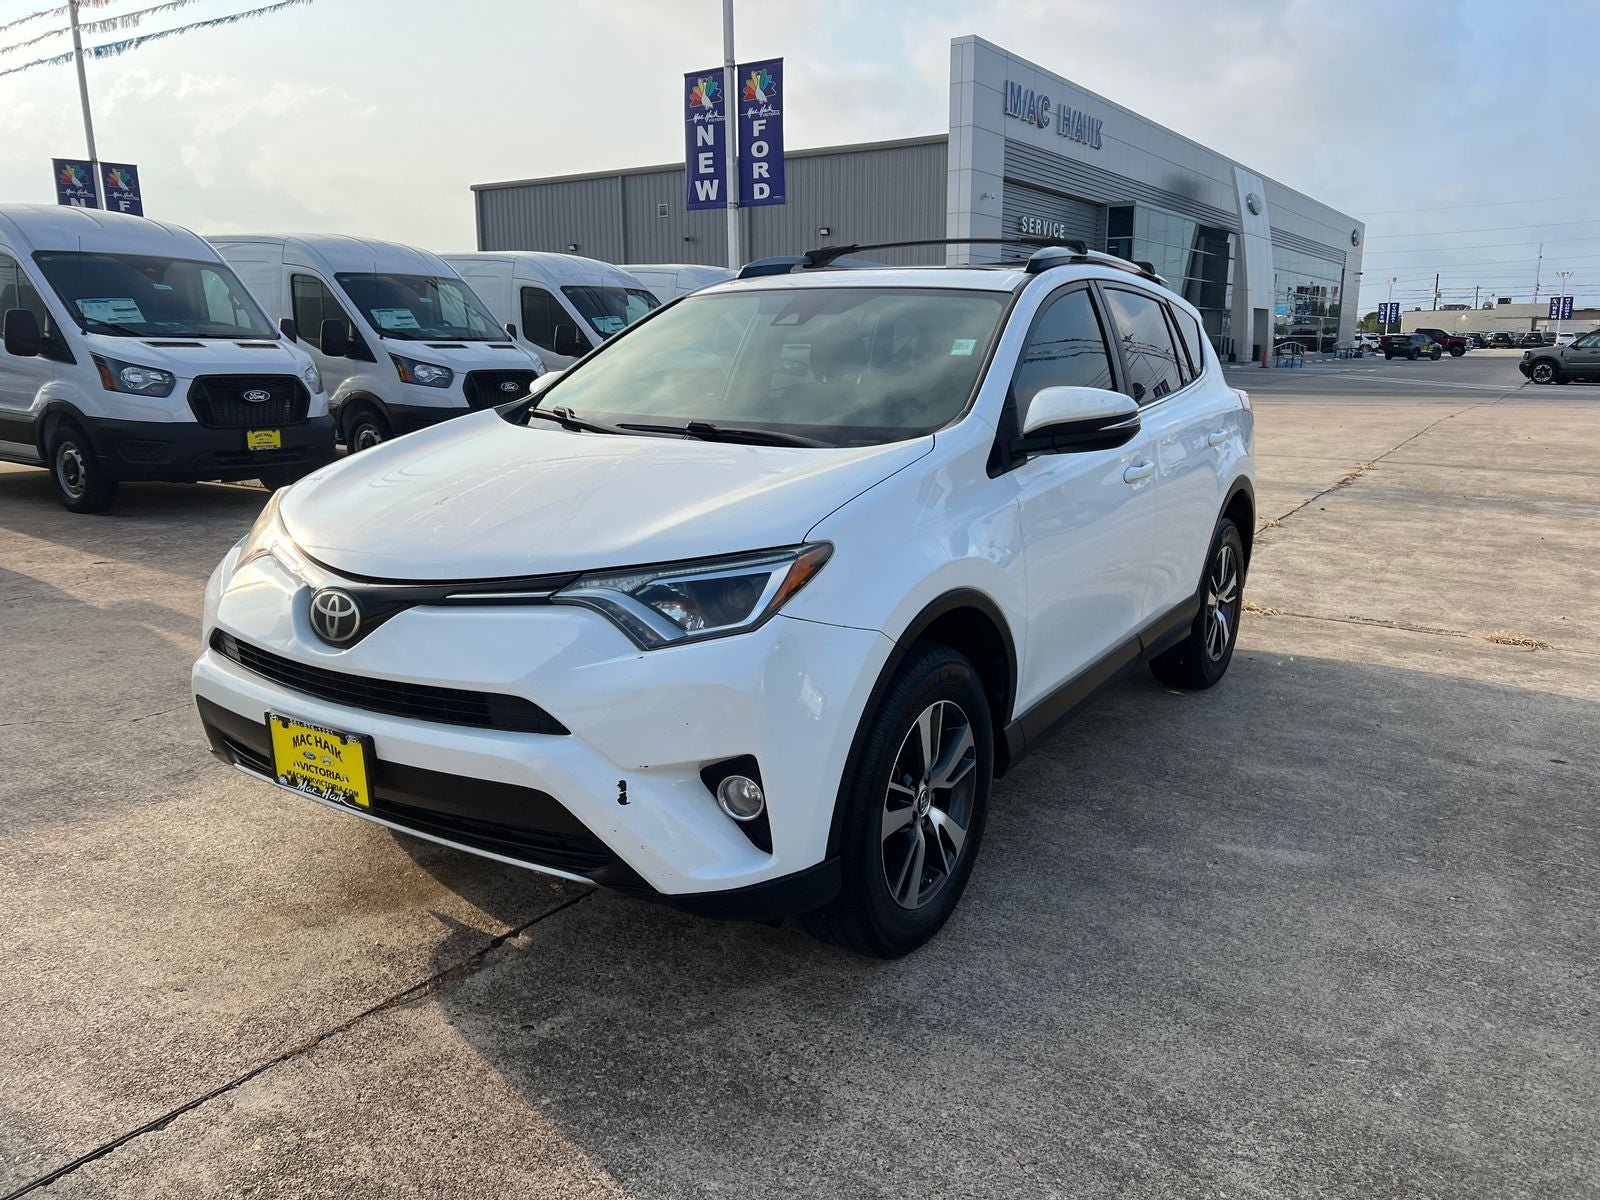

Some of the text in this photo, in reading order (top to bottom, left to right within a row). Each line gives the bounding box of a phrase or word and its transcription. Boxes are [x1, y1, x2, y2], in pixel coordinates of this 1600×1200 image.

[1005, 80, 1103, 149] MAC HAIK
[694, 124, 719, 201] NEW
[750, 119, 771, 200] FORD
[1021, 216, 1065, 239] SERVICE
[1550, 306, 1558, 319] NEW
[292, 734, 313, 749] MAC
[314, 736, 343, 763] HAIK
[299, 761, 342, 782] VICTORIA
[296, 779, 319, 796] Mac
